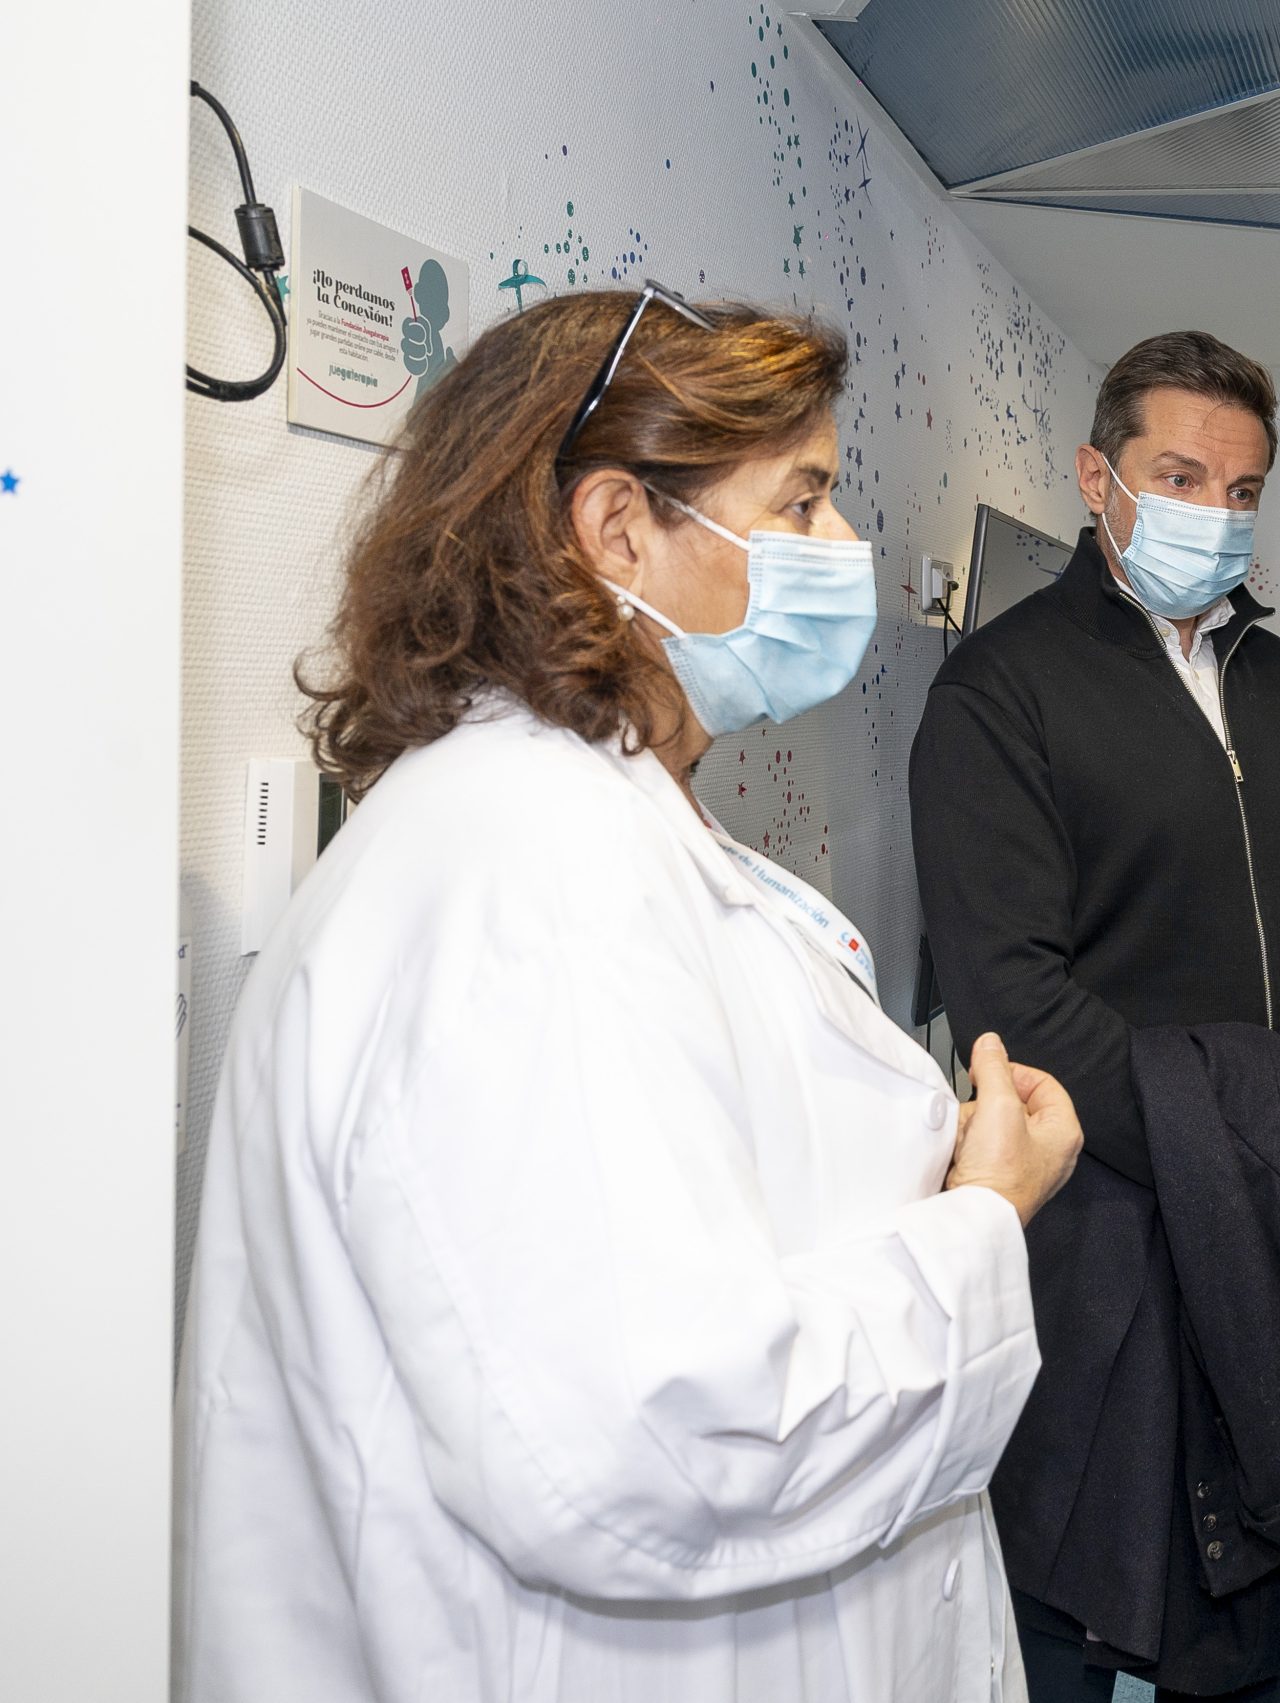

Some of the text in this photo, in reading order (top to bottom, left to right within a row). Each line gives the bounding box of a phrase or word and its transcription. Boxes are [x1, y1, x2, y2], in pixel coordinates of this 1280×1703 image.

[313, 268, 395, 312] ¡No perdamos
[317, 286, 393, 328] la Conexión!
[341, 317, 363, 332] Fundación
[363, 325, 390, 342] Juegaterapia
[329, 364, 378, 387] juegaterapia
[751, 864, 830, 929] Humanización
